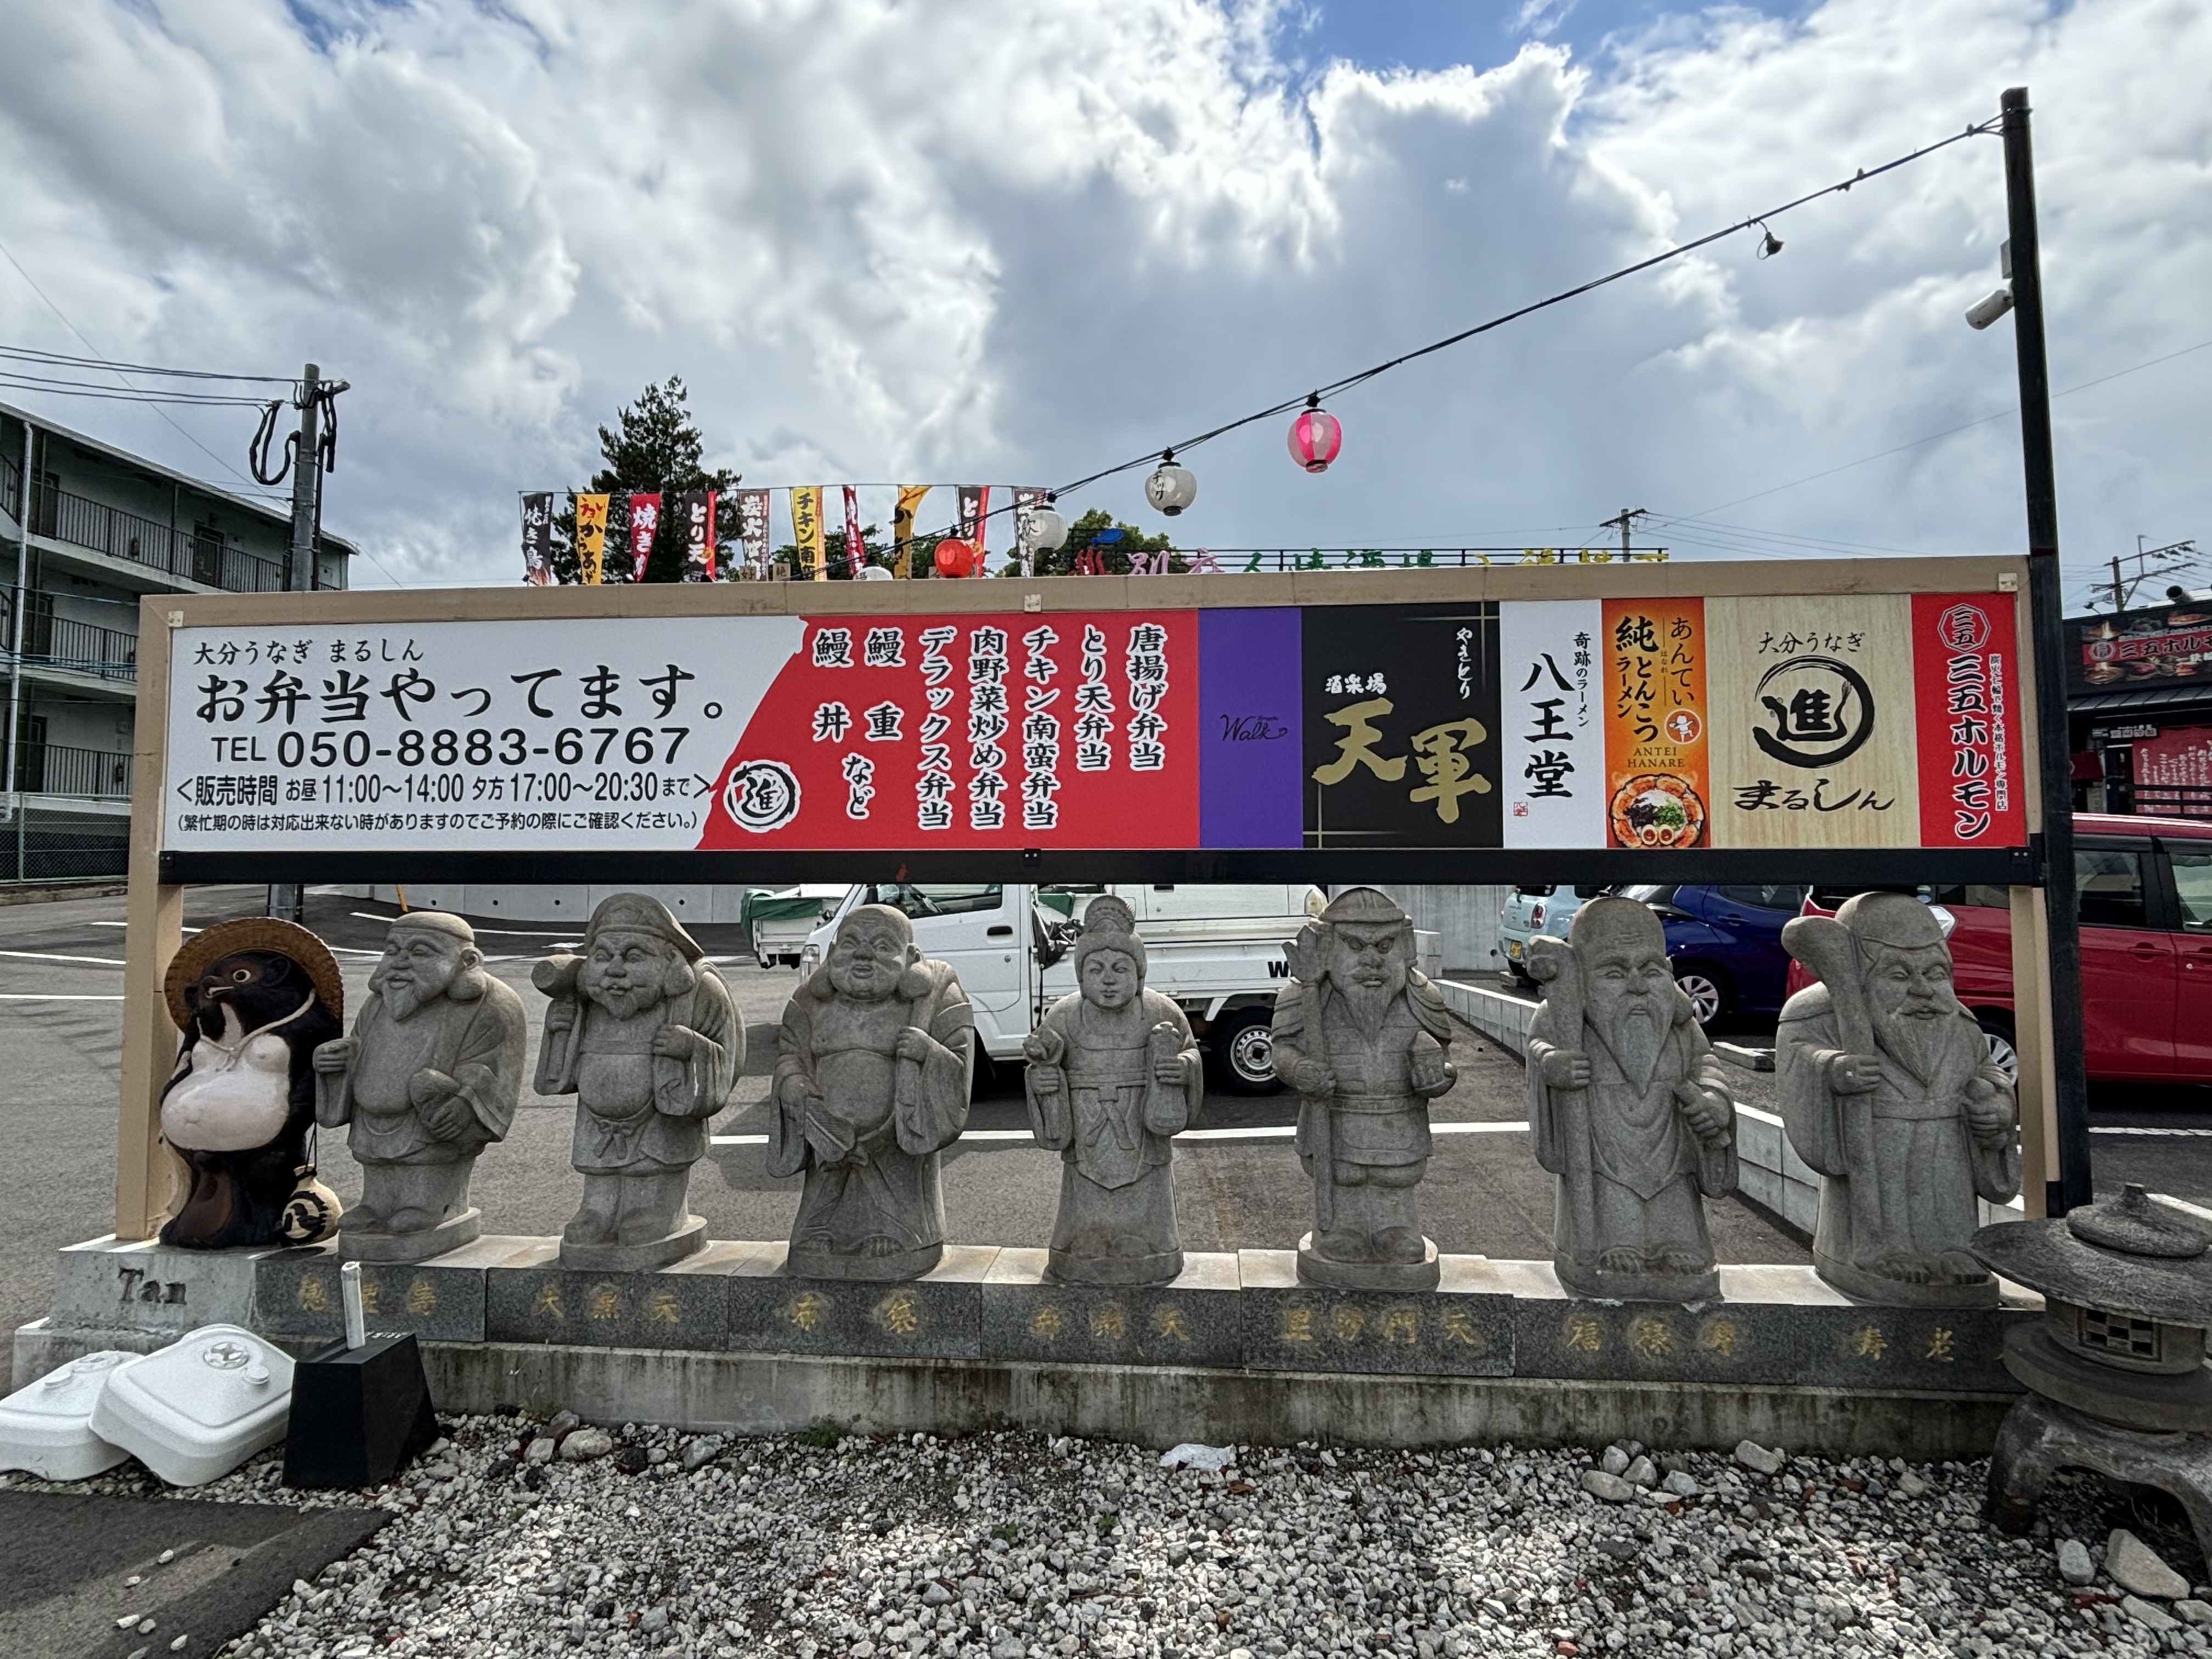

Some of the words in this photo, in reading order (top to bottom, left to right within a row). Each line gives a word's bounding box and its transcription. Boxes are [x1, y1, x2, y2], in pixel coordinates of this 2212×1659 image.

[689, 503, 708, 565] とり天
[963, 496, 978, 553] とり
[194, 640, 313, 665] 大分うなぎ
[330, 639, 425, 662] まるしん
[1758, 632, 1865, 654] 大分うなぎ
[1952, 609, 1975, 646] 三五
[1457, 627, 1473, 700] やきとり
[1572, 631, 1592, 728] 奇跡のラーメン
[1615, 616, 1659, 743] 純とんこつ
[1616, 657, 1634, 719] ラーメン
[1670, 618, 1695, 706] あんてい
[196, 664, 723, 725] お弁当やってます。
[1075, 623, 1114, 771] とり天弁当
[1127, 623, 1168, 771] 唐揚げ弁当
[211, 737, 266, 762] TEL
[277, 727, 690, 768] 050-8883-6767
[916, 624, 957, 830] デラックス弁当
[968, 624, 1008, 830] 肉野菜炒め弁当
[1022, 624, 1060, 830] チキン南蛮弁当
[1520, 653, 1576, 799] 八王堂
[1633, 747, 1677, 757] ANTEI
[1947, 653, 1991, 839] 三五ホルモン
[842, 752, 874, 820] など
[1627, 758, 1685, 769] HANARE
[1733, 778, 1895, 812] まるしん
[118, 1267, 187, 1305] Tan
[533, 1288, 680, 1323] 大黒天
[1857, 1325, 2004, 1362] 寿老
